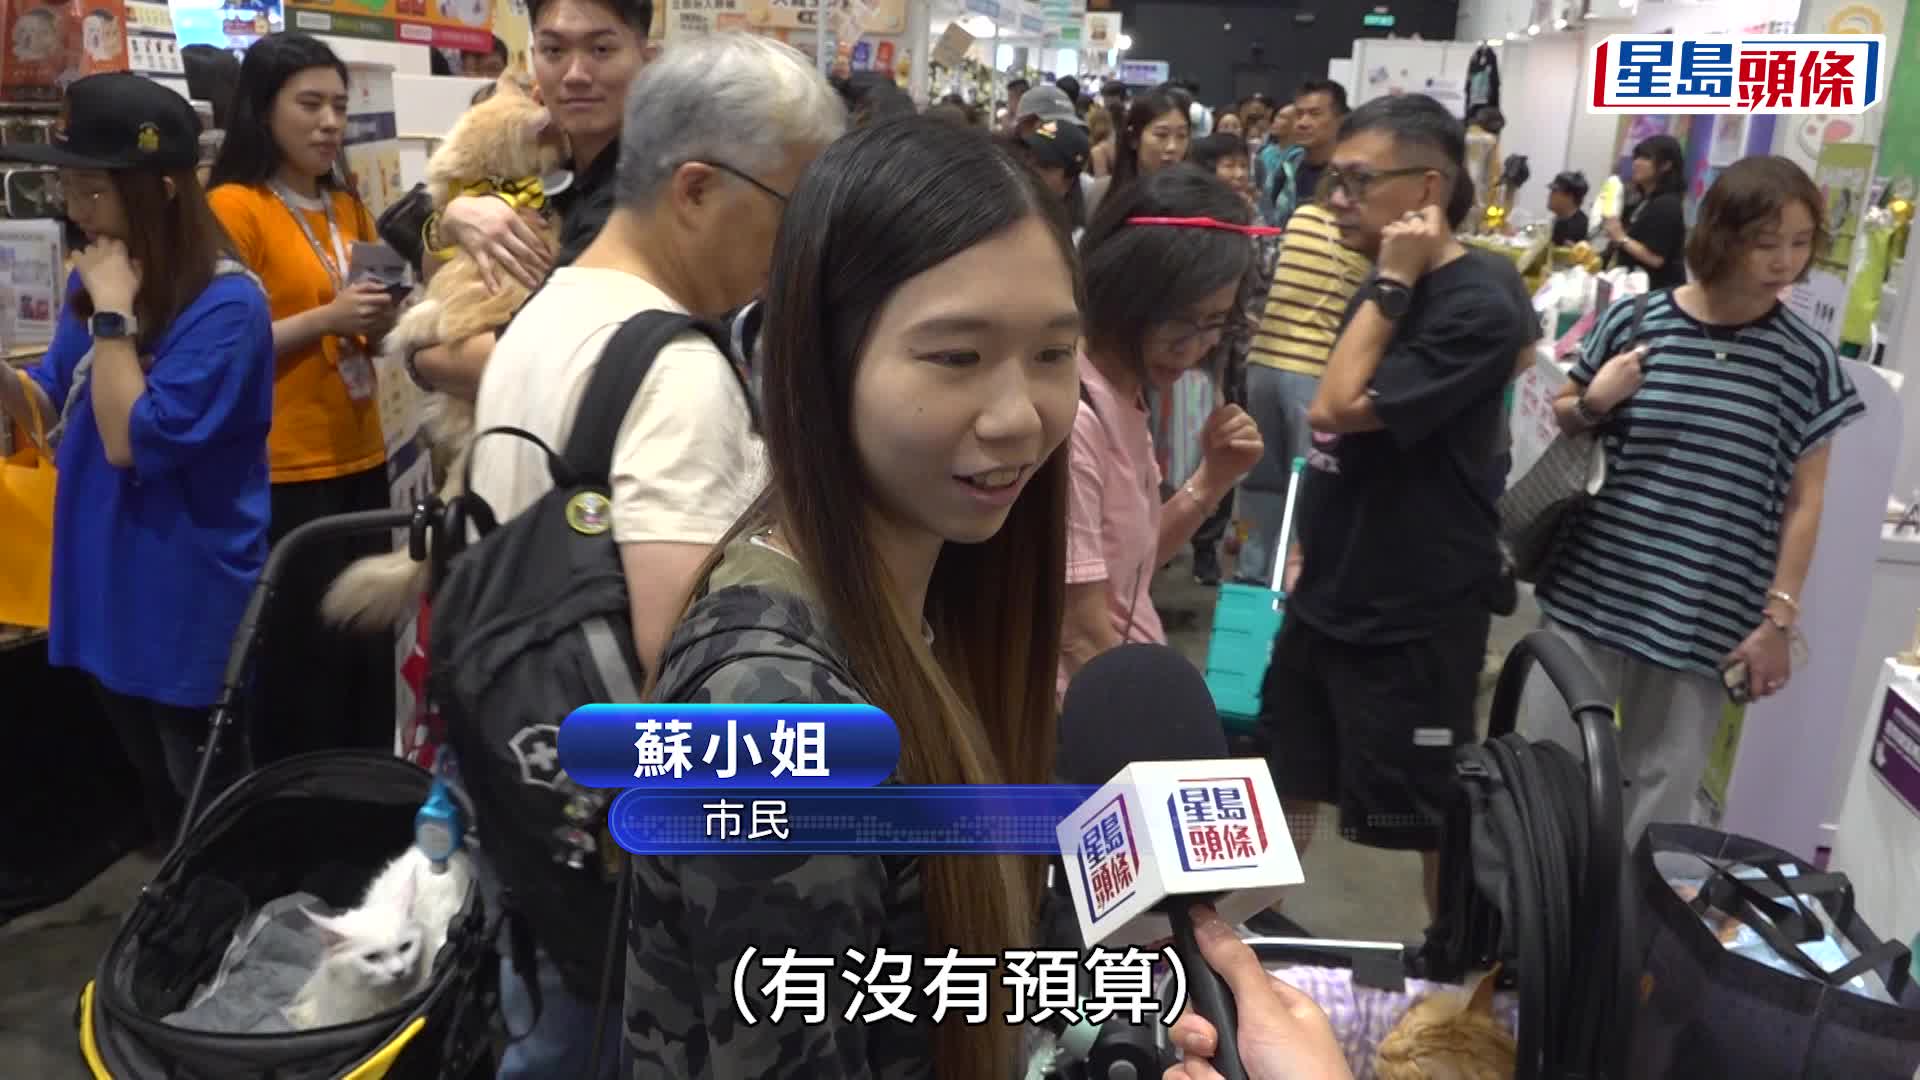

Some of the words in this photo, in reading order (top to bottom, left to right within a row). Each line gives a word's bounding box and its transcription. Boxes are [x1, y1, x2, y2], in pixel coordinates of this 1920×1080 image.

[1181, 787, 1247, 823] 星島
[1083, 812, 1124, 868] 星島
[1188, 825, 1256, 863] 頭條
[1092, 854, 1133, 910] 頭條
